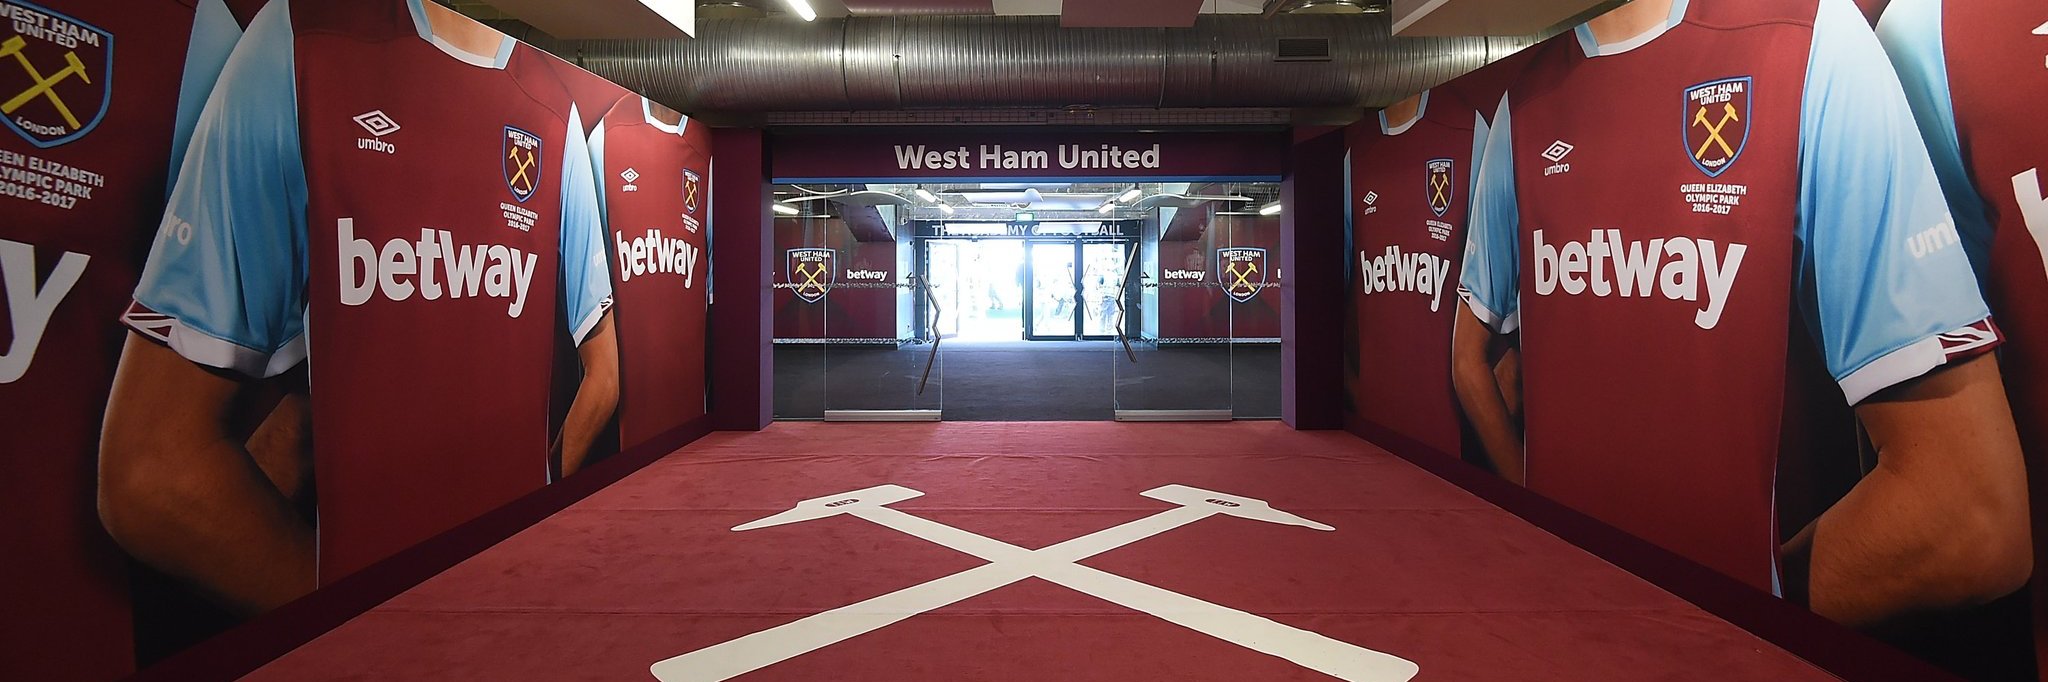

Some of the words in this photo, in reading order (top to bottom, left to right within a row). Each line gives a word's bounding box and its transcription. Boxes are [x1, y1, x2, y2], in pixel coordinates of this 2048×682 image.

[14, 20, 77, 49] UNITED
[52, 18, 99, 47] HAM
[1690, 86, 1717, 101] WEST
[1718, 82, 1743, 95] HAM
[1700, 93, 1731, 106] UNITED
[16, 116, 66, 136] LONDON
[507, 130, 524, 141] WEST
[357, 137, 395, 154] umbro
[894, 145, 970, 170] West
[979, 145, 1048, 170] Ham
[1058, 144, 1160, 170] United
[1701, 157, 1726, 167] LONDON
[29, 156, 104, 188] ELIZABETH
[1544, 162, 1570, 176] umbro
[0, 166, 53, 189] YMPIC
[55, 178, 92, 200] PARK
[1680, 184, 1706, 193] QUEEN
[1706, 184, 1747, 195] ELIZABETH
[0, 181, 77, 210] 2016-2017
[1685, 193, 1718, 204] OLYMPIC
[1719, 195, 1739, 205] PARK
[1692, 203, 1731, 215] 2016-2017
[616, 229, 698, 289] betway
[1243, 250, 1260, 258] HAM
[337, 217, 538, 318] betway
[846, 269, 887, 281] betway
[1164, 269, 1205, 281] betway
[1360, 246, 1450, 312] betway
[1533, 229, 1748, 330] betway
